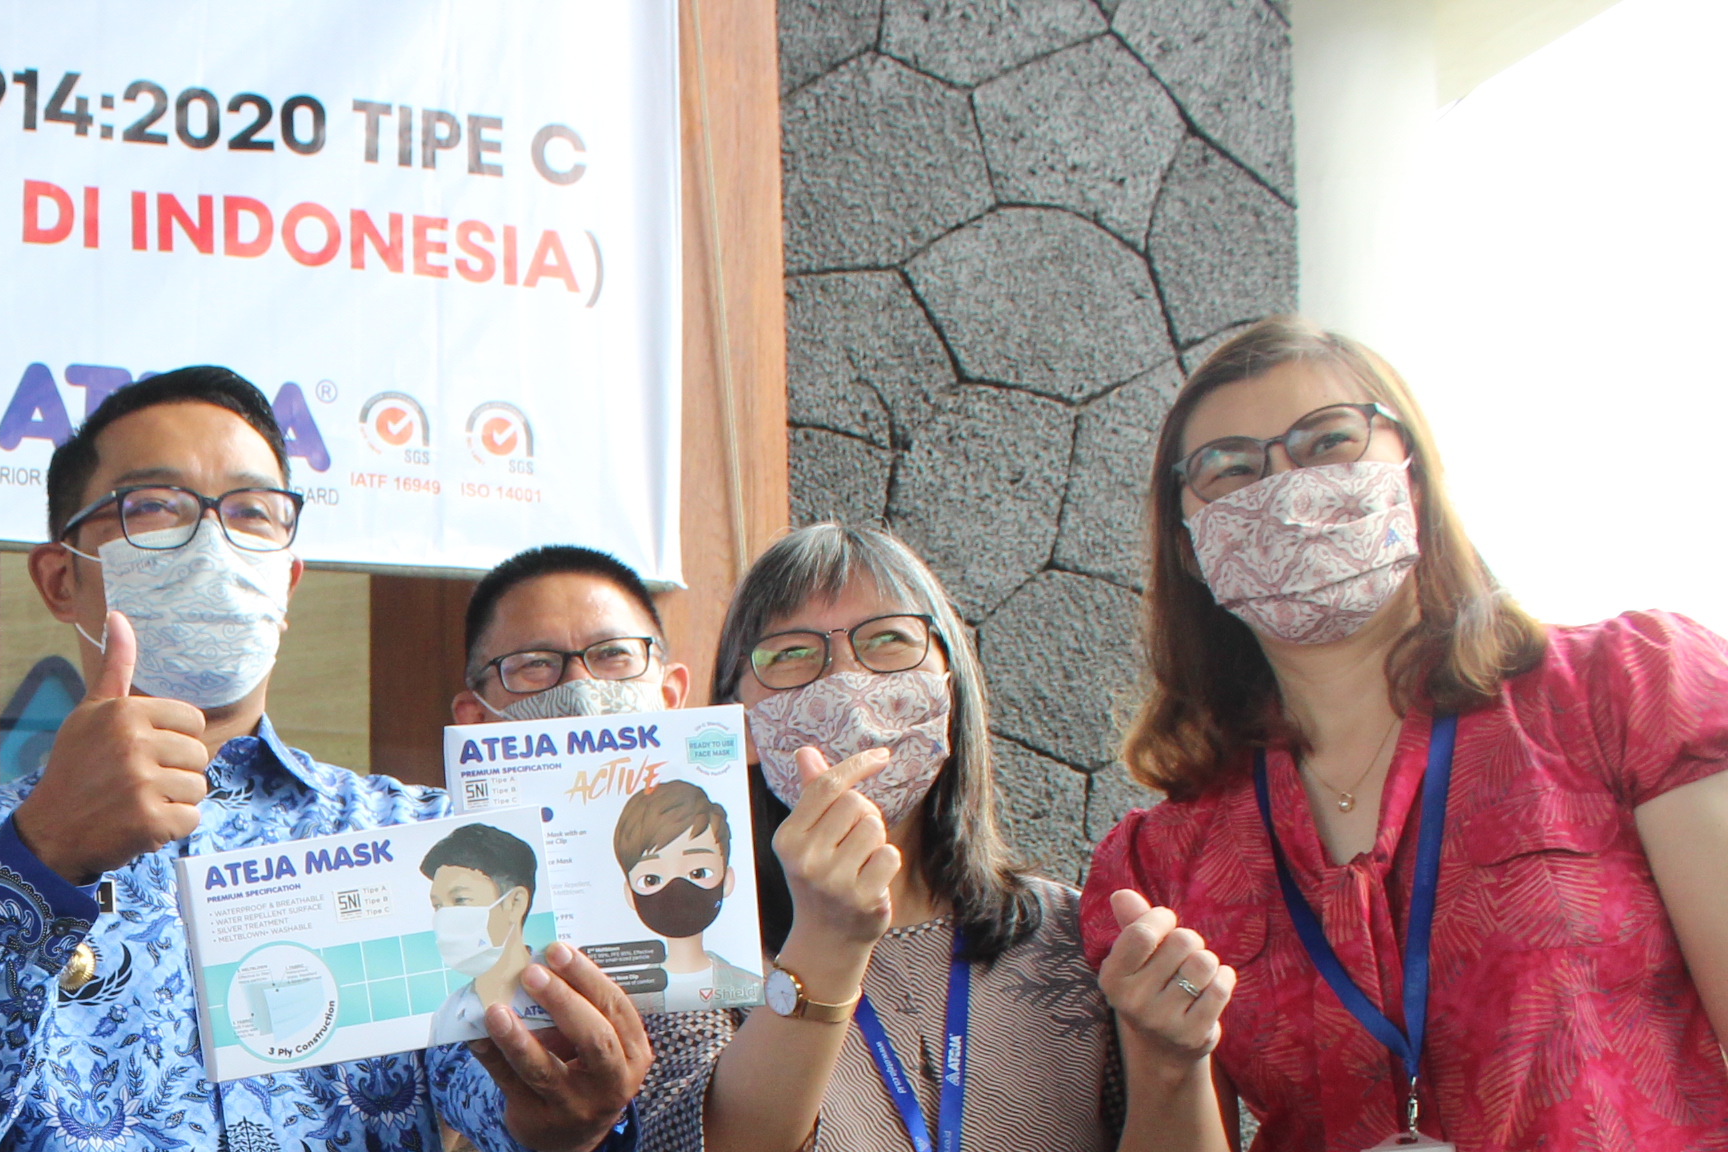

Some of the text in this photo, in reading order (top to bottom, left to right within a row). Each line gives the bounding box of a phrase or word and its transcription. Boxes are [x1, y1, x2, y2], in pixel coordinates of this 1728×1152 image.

[352, 97, 504, 178] TIPE
[530, 122, 587, 186] C
[22, 178, 100, 250] DI
[131, 190, 605, 309] INDONESIA)
[404, 448, 431, 466] SGS
[508, 459, 535, 476] SGS
[349, 471, 442, 496] IATF 16949
[460, 482, 542, 504] ISO 14001
[459, 723, 662, 765] ATEJA MASK
[688, 739, 735, 750] READY TO USE
[694, 749, 731, 758] FACE MASK
[460, 762, 562, 779] PREMIUM SPECIFICATION
[563, 754, 670, 807] ACTIVE
[465, 782, 489, 799] SNI
[205, 839, 394, 891] ATEJA MASK
[206, 883, 302, 904] PREMIUM SPECIFICATION
[338, 892, 362, 911] SNI
[214, 902, 267, 918] WATERPROOF
[275, 893, 325, 907] BREATHABLE
[215, 902, 323, 927] WATER REPELLENT SURFACE
[216, 917, 289, 935] SILVER TREATMENT
[270, 921, 313, 936] WASHABLE
[713, 985, 757, 1001] Shield
[268, 1000, 335, 1059] 3 Ply Construction
[947, 1034, 962, 1072] ATEJA
